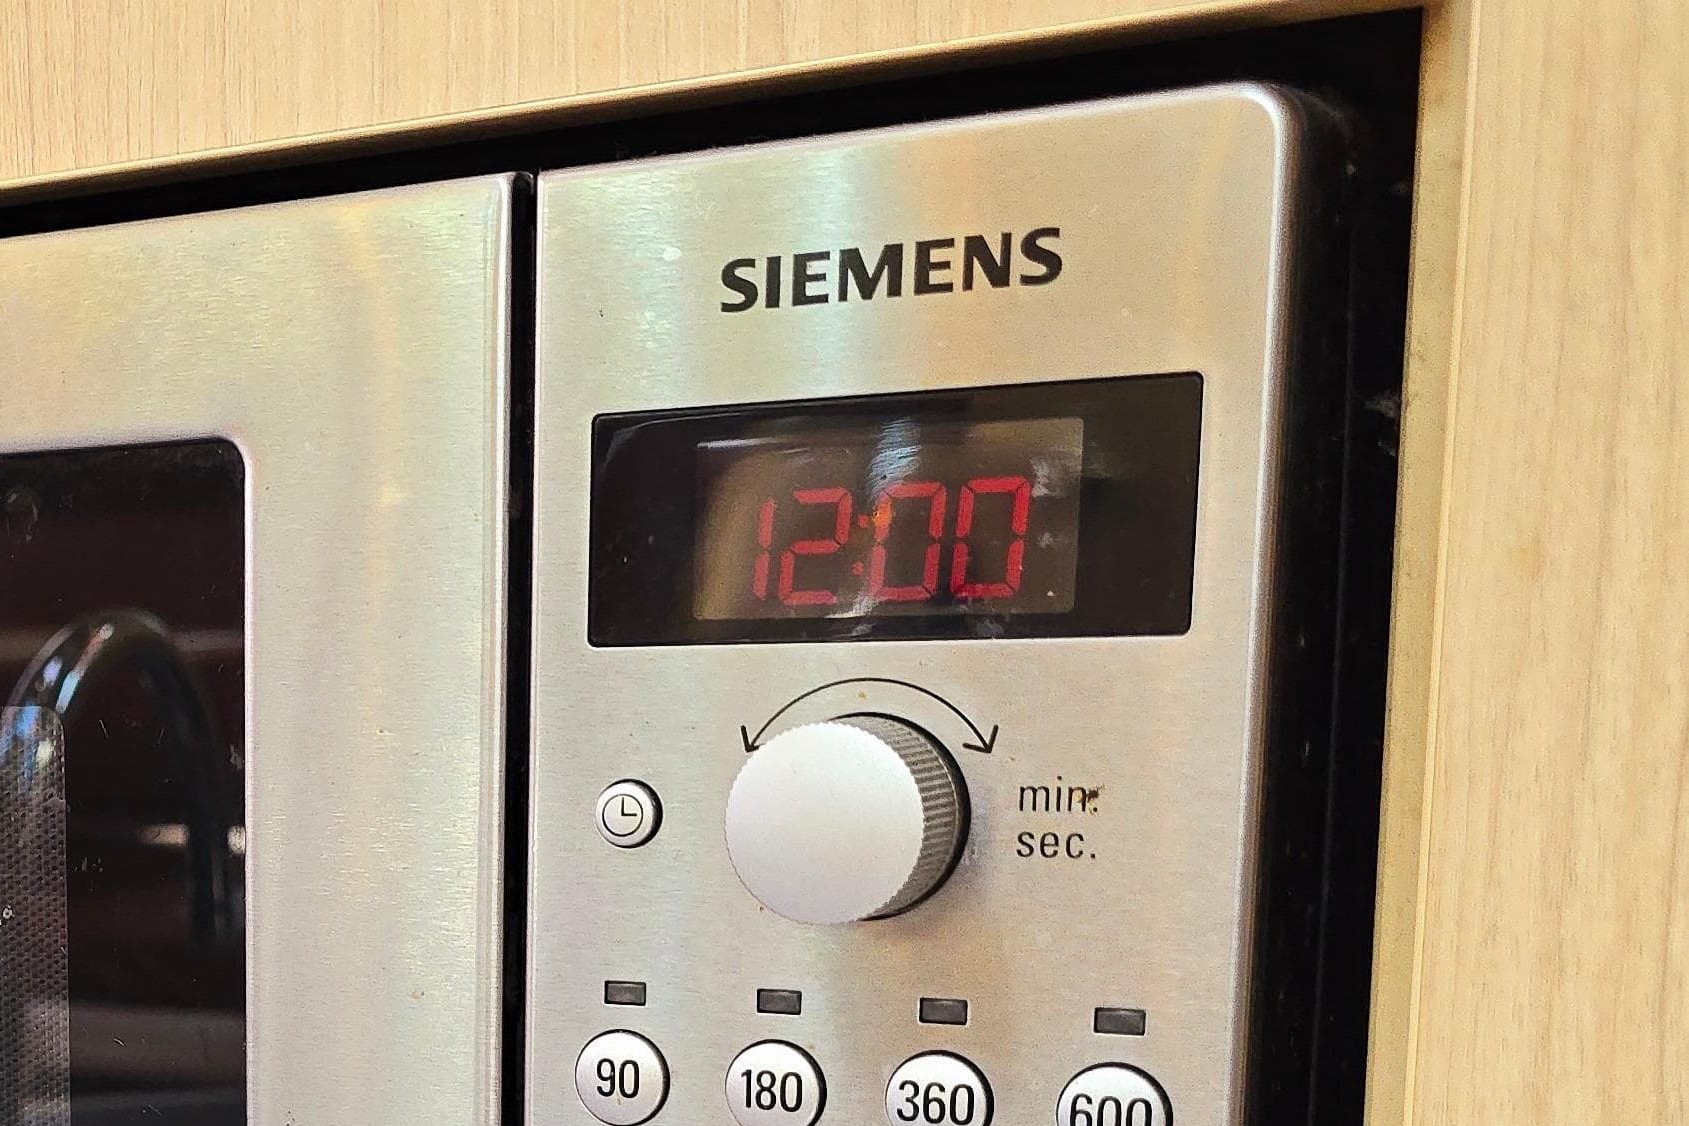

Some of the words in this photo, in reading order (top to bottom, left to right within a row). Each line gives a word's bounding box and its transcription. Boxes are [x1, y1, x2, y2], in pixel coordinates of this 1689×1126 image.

[721, 227, 1063, 312] SIEMENS
[752, 476, 1032, 606] 12:00
[1018, 775, 1098, 813] min.
[1016, 831, 1096, 859] sec.
[596, 1058, 641, 1099] 90
[741, 1069, 803, 1113] 180
[896, 1079, 975, 1126] 360
